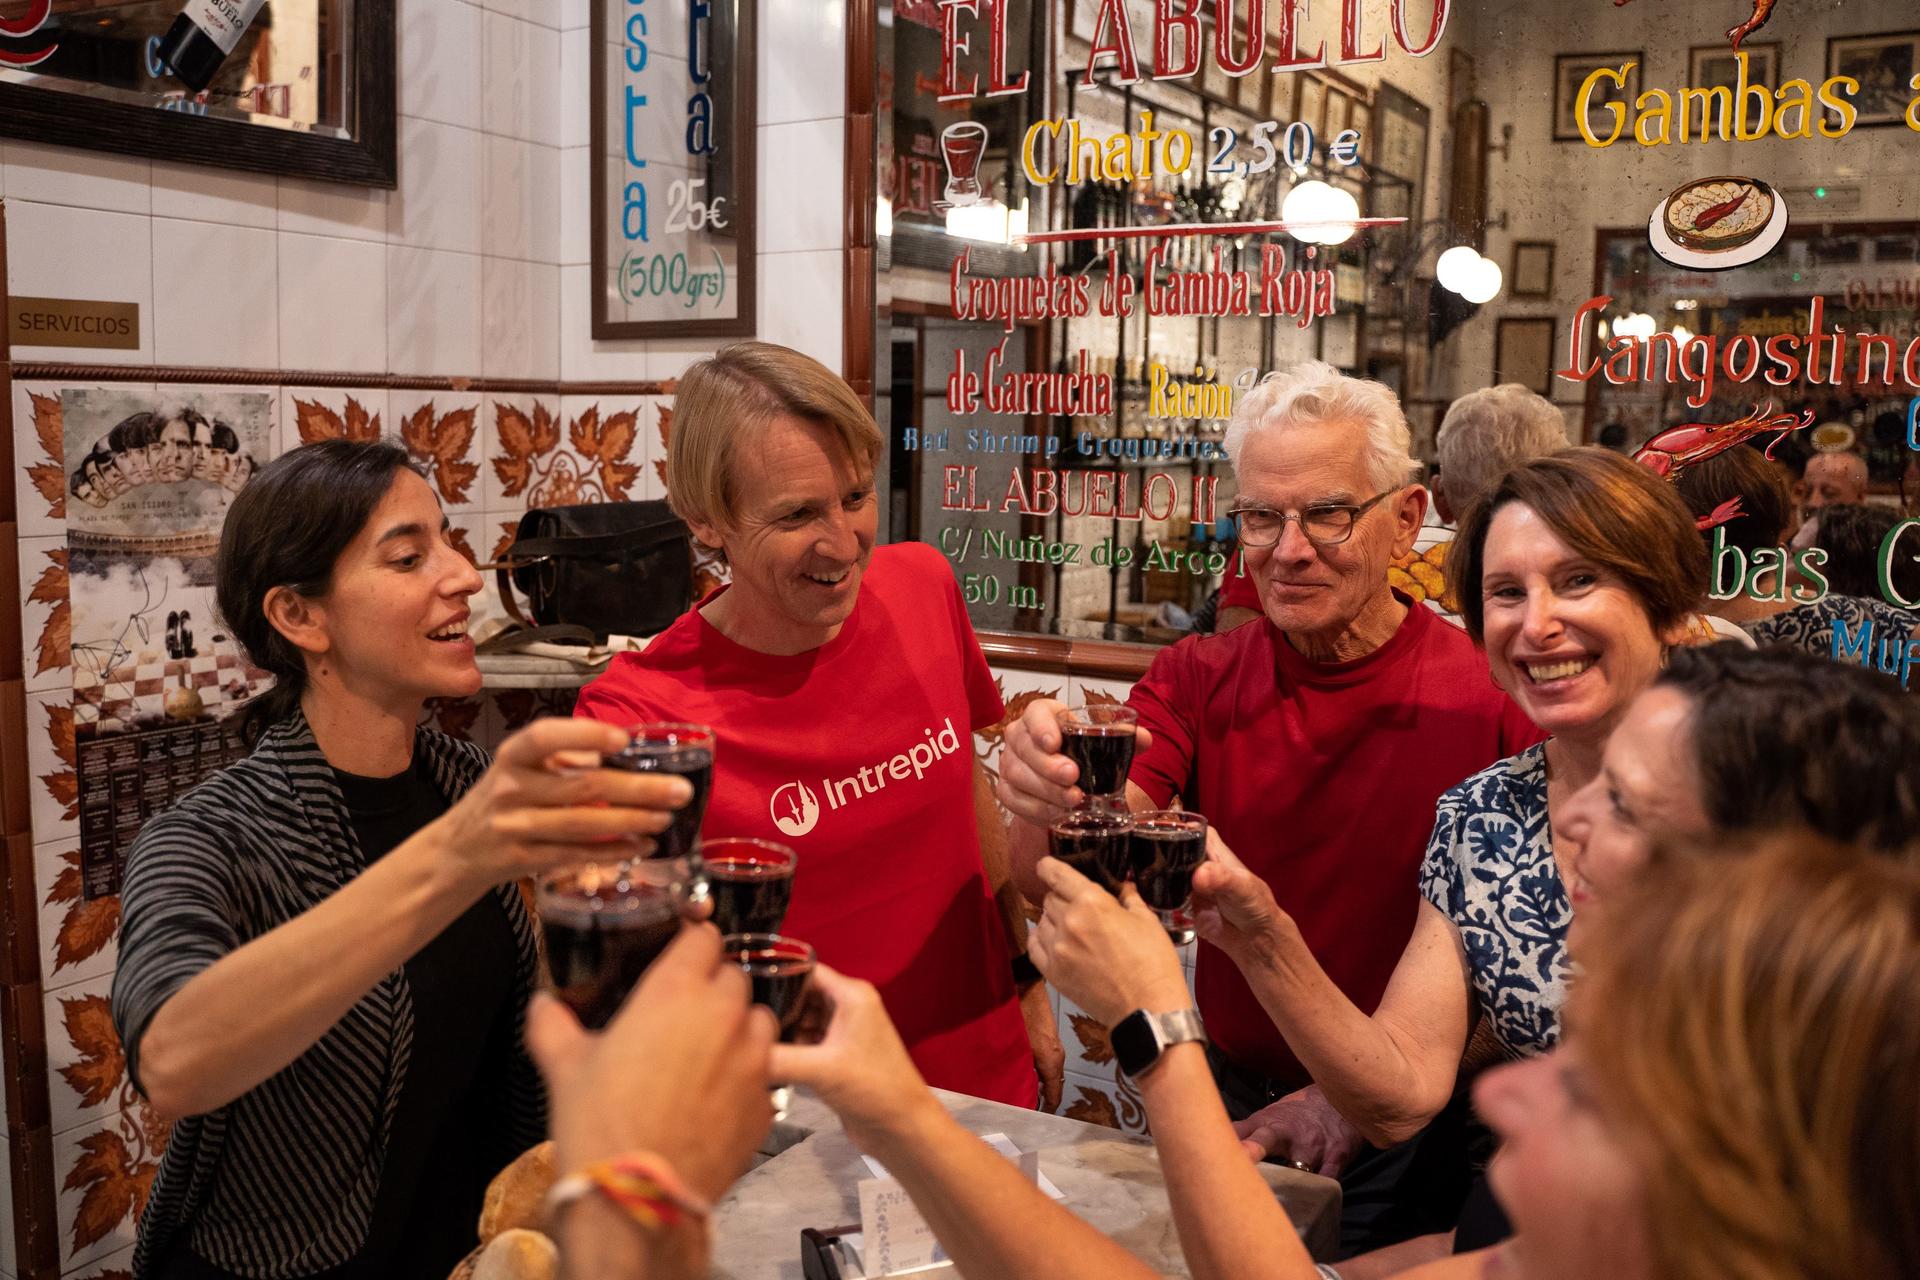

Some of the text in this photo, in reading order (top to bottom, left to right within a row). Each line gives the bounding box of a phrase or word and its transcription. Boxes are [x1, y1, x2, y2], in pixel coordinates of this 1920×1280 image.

[937, 0, 1451, 102] EL ABUELO
[622, 0, 649, 243] sta
[1575, 50, 1860, 148] Gambas
[1021, 110, 1361, 186] Chato 2,50 €
[665, 178, 728, 234] 25€
[618, 248, 725, 309] (500grs)
[951, 237, 1336, 333] Croquetas de Gamba Roja
[19, 312, 130, 335] SERVICIOS
[947, 336, 1233, 420] de Garrucha Ración
[903, 427, 1229, 463] Red Shrimp Croquettes
[941, 465, 1219, 525] EL ABUELO II
[938, 527, 973, 563] C/
[981, 527, 1082, 566] Nuñez
[1091, 537, 1134, 569] de
[1142, 540, 1227, 576] Arce
[963, 572, 1046, 611] 50 m.
[823, 717, 960, 810] Intrepid
